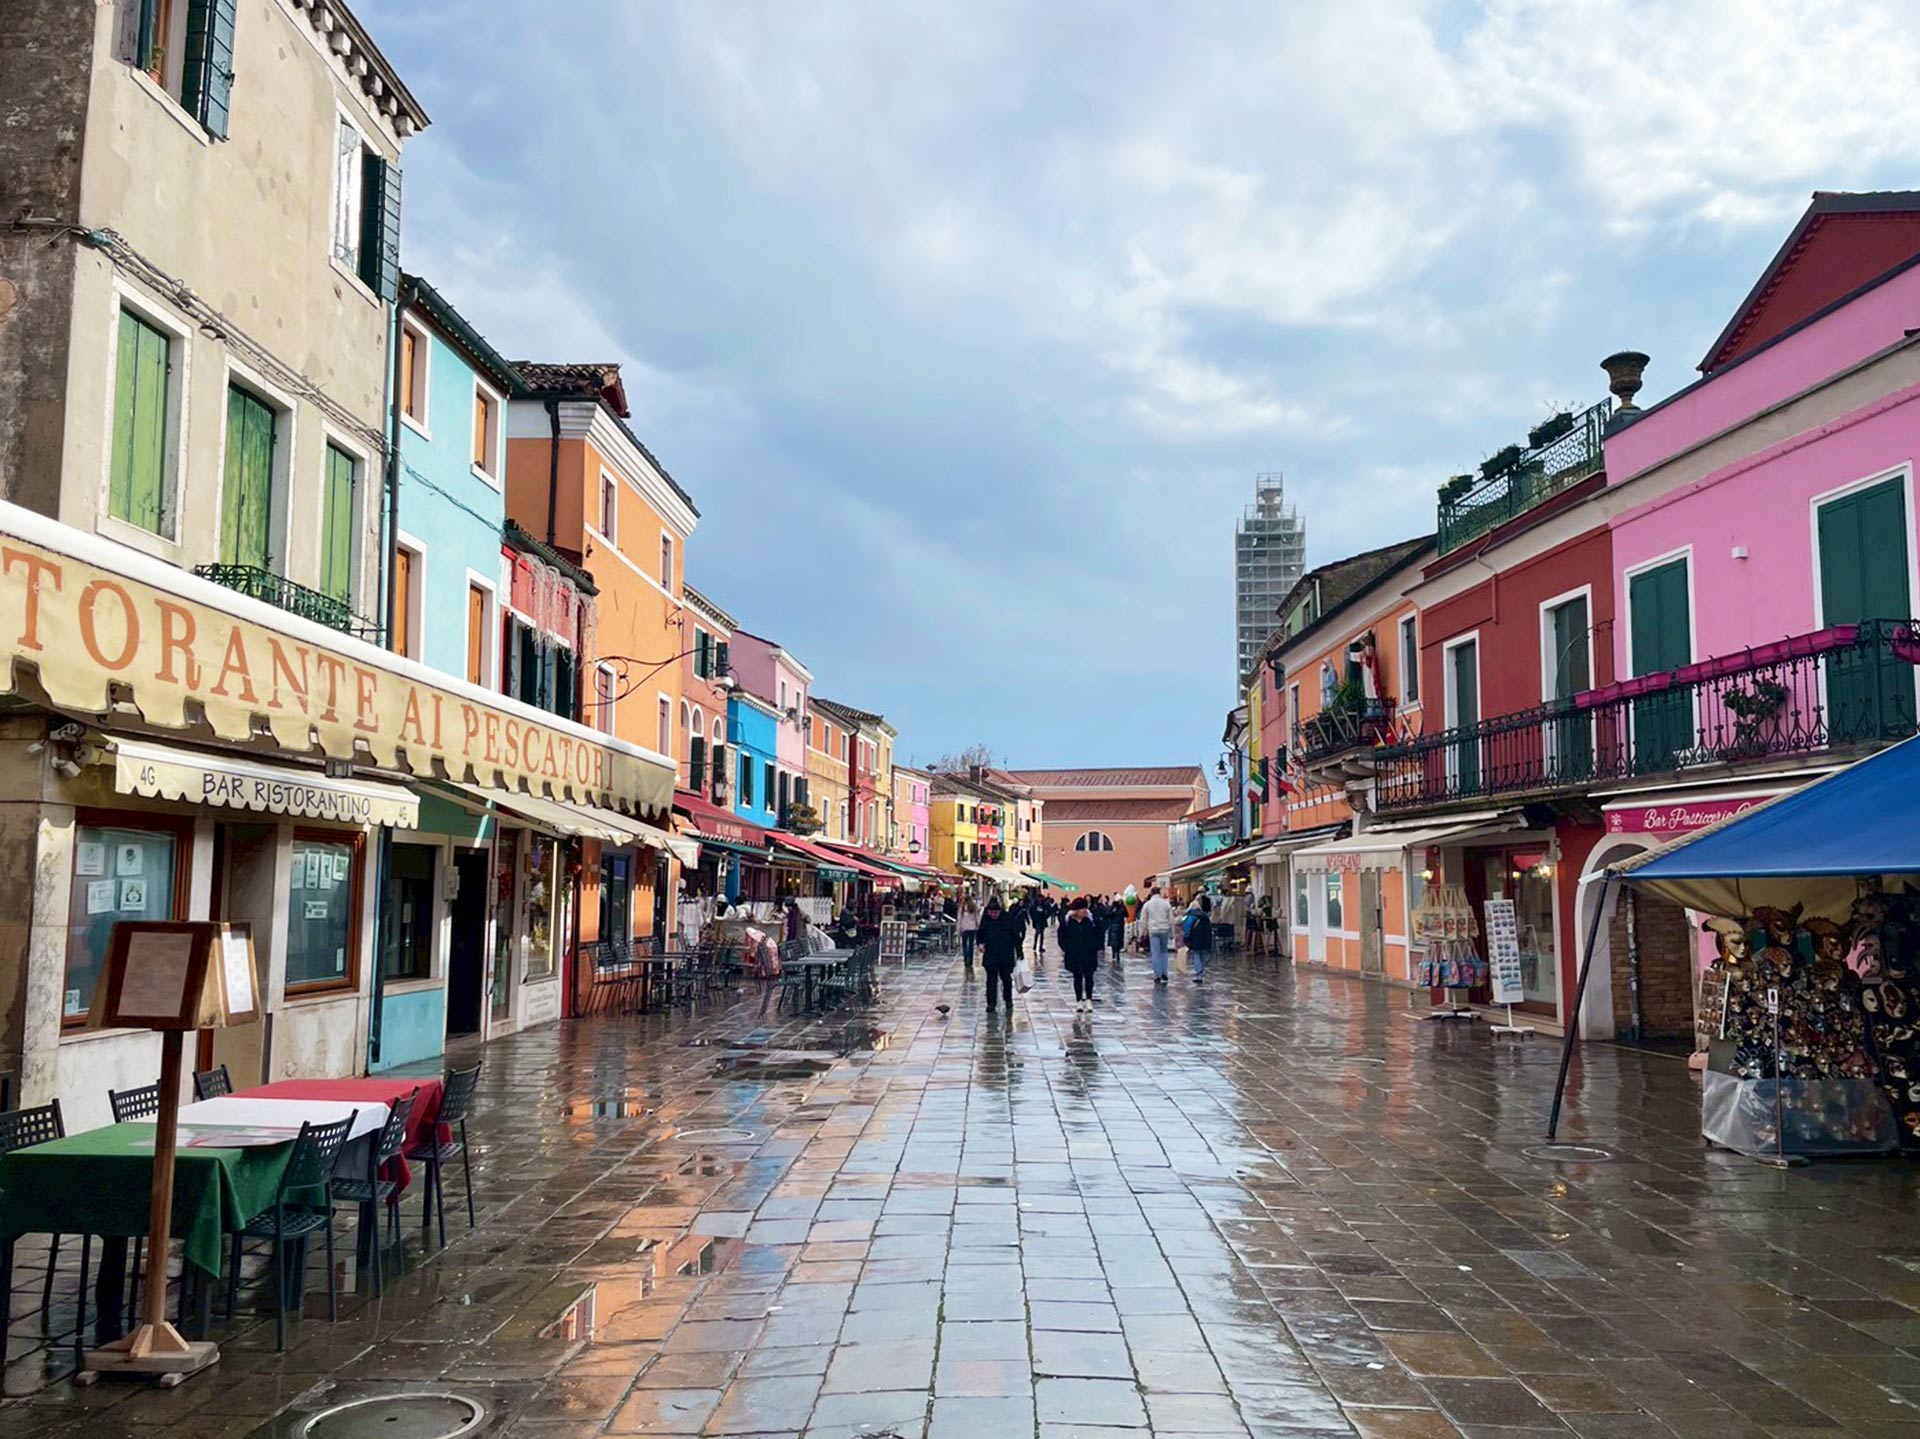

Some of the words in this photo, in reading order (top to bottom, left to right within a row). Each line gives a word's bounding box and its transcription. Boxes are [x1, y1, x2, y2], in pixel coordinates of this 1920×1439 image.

[399, 685, 444, 750] AI
[461, 703, 614, 791] PESCATORI
[140, 766, 155, 786] 4G
[202, 773, 244, 799] BAR
[255, 781, 371, 817] RISTORANTINO
[1643, 808, 1667, 829] Bar
